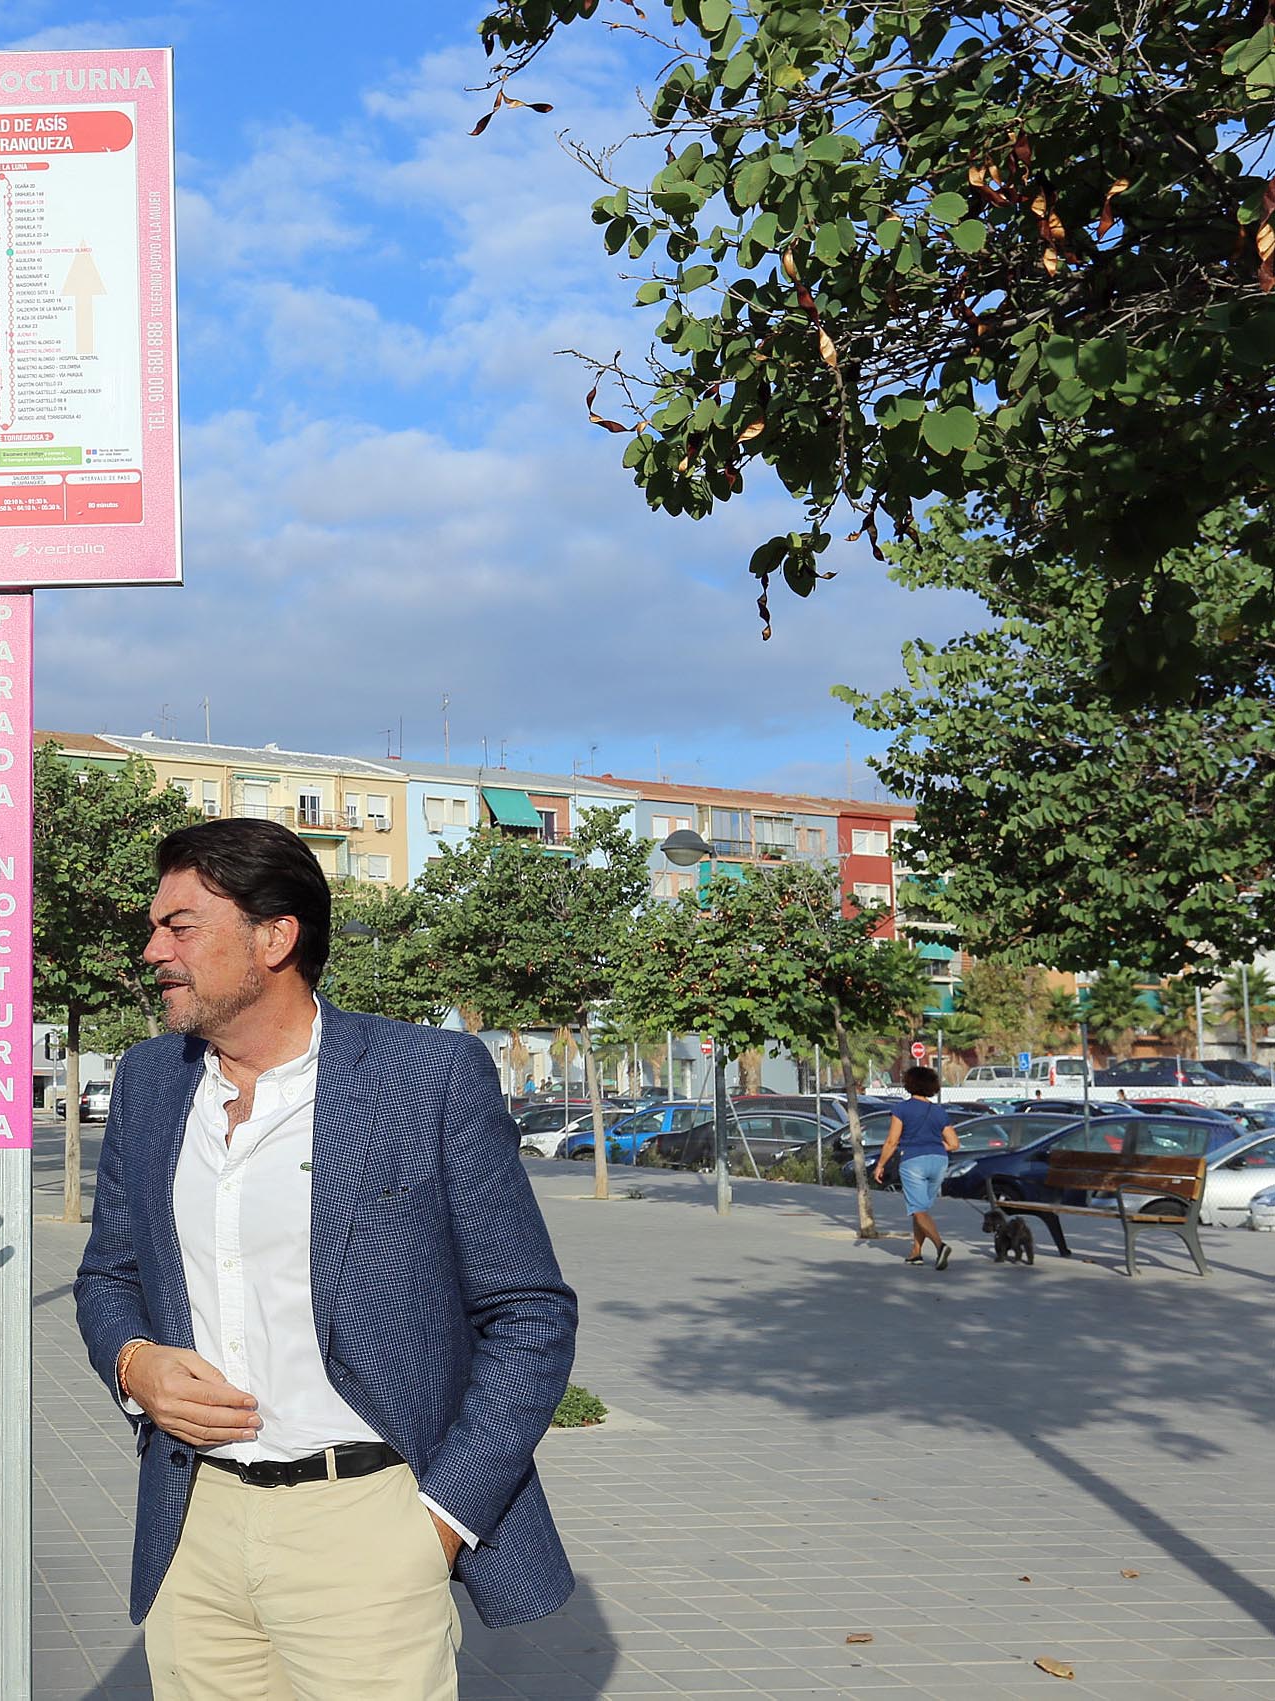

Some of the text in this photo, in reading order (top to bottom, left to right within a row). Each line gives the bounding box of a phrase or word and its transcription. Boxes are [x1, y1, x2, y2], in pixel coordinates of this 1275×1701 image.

[14, 118, 32, 132] DE
[36, 114, 68, 132] ASÍS
[149, 191, 161, 220] MUJER
[149, 222, 161, 233] LA
[150, 244, 162, 270] APOYO
[147, 321, 164, 346] 888
[147, 349, 164, 374] 580
[147, 377, 164, 402] 900
[33, 542, 105, 555] vectalia
